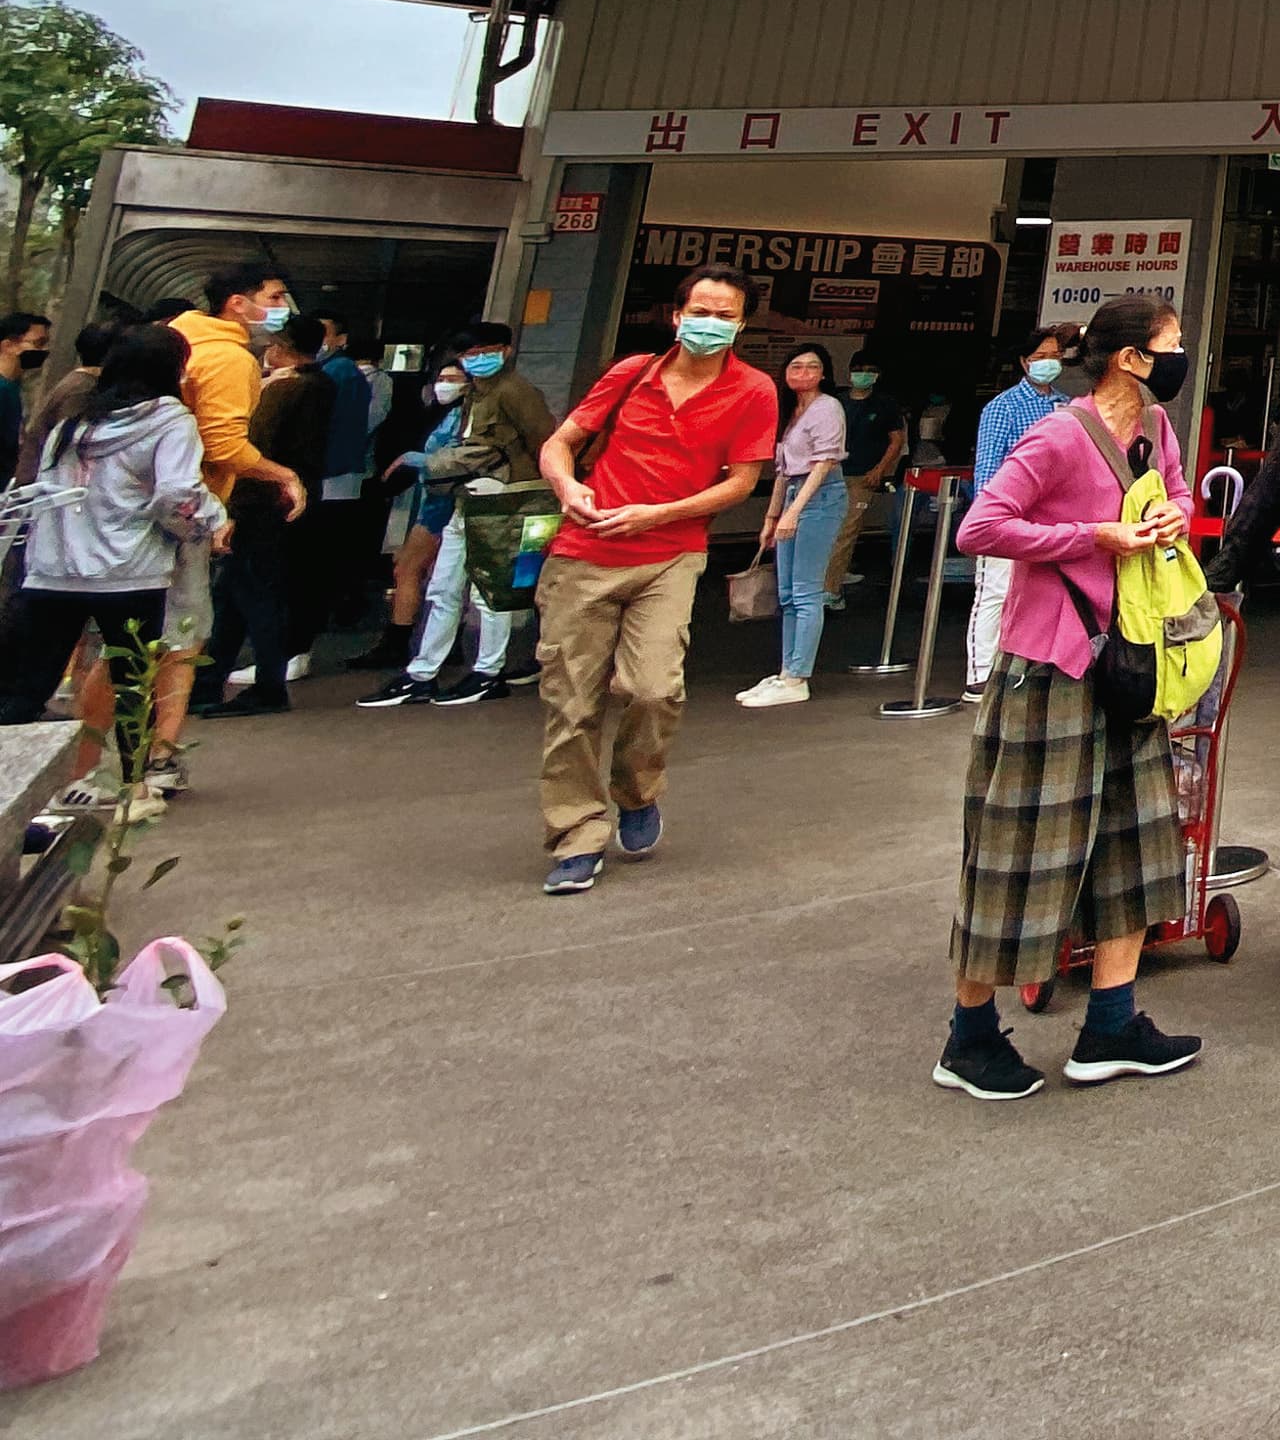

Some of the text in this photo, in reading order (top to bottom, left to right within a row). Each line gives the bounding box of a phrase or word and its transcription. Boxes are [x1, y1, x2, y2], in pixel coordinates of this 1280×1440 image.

[645, 112, 780, 152] 出口
[852, 112, 1011, 146] EXIT
[558, 214, 594, 228] 268
[635, 229, 985, 278] MBERSHIP 會員部
[1058, 231, 1182, 256] 營業時間
[1055, 260, 1178, 273] WAREHOUSE HOURS
[1052, 287, 1100, 304] 10:00
